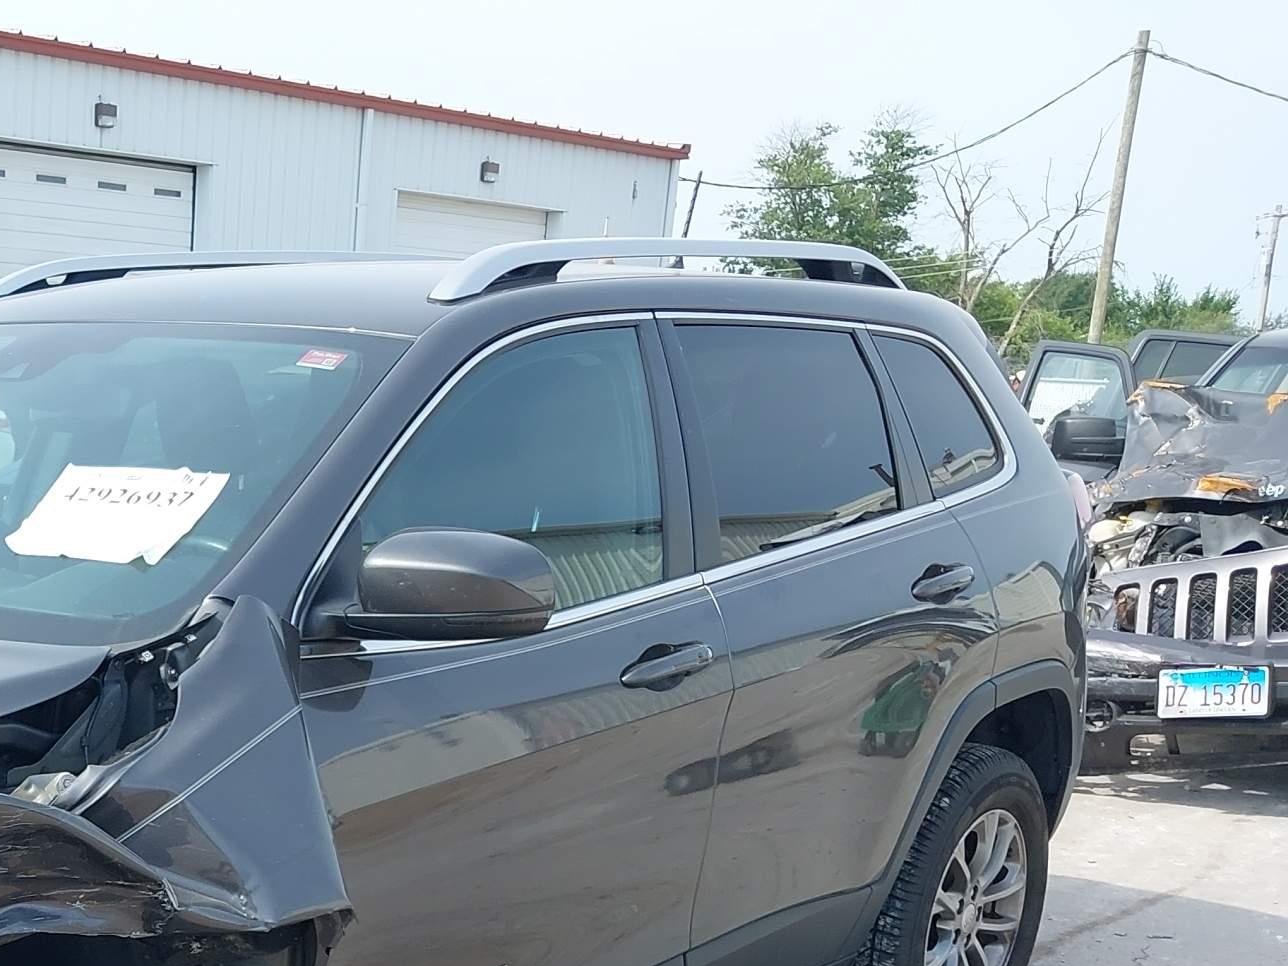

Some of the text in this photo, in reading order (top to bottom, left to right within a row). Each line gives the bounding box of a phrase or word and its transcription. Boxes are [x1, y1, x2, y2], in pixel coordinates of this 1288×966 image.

[64, 485, 195, 507] 42926937
[1165, 682, 1262, 708] DZ 15370
